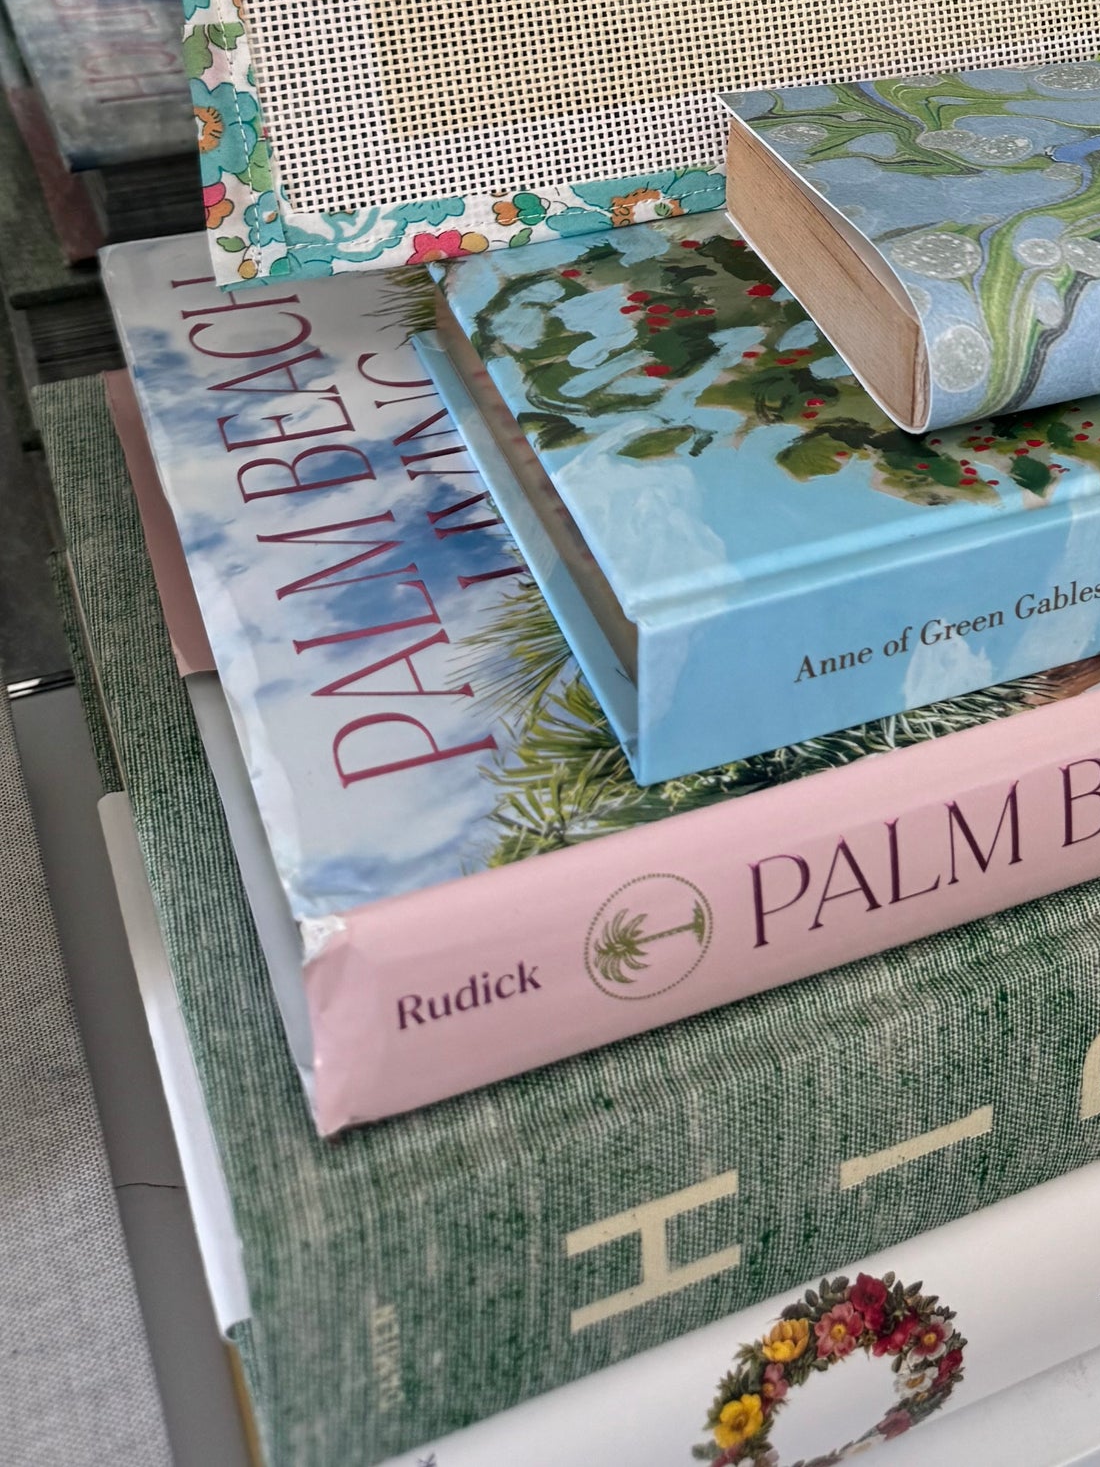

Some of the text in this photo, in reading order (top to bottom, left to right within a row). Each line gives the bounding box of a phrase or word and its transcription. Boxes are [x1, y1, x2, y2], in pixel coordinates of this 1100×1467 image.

[171, 276, 499, 790] PALM BEACH
[792, 653, 874, 684] Anne
[882, 626, 913, 658] of
[919, 610, 1005, 647] Green
[747, 779, 1024, 949] PALM
[396, 959, 543, 1031] Rudick
